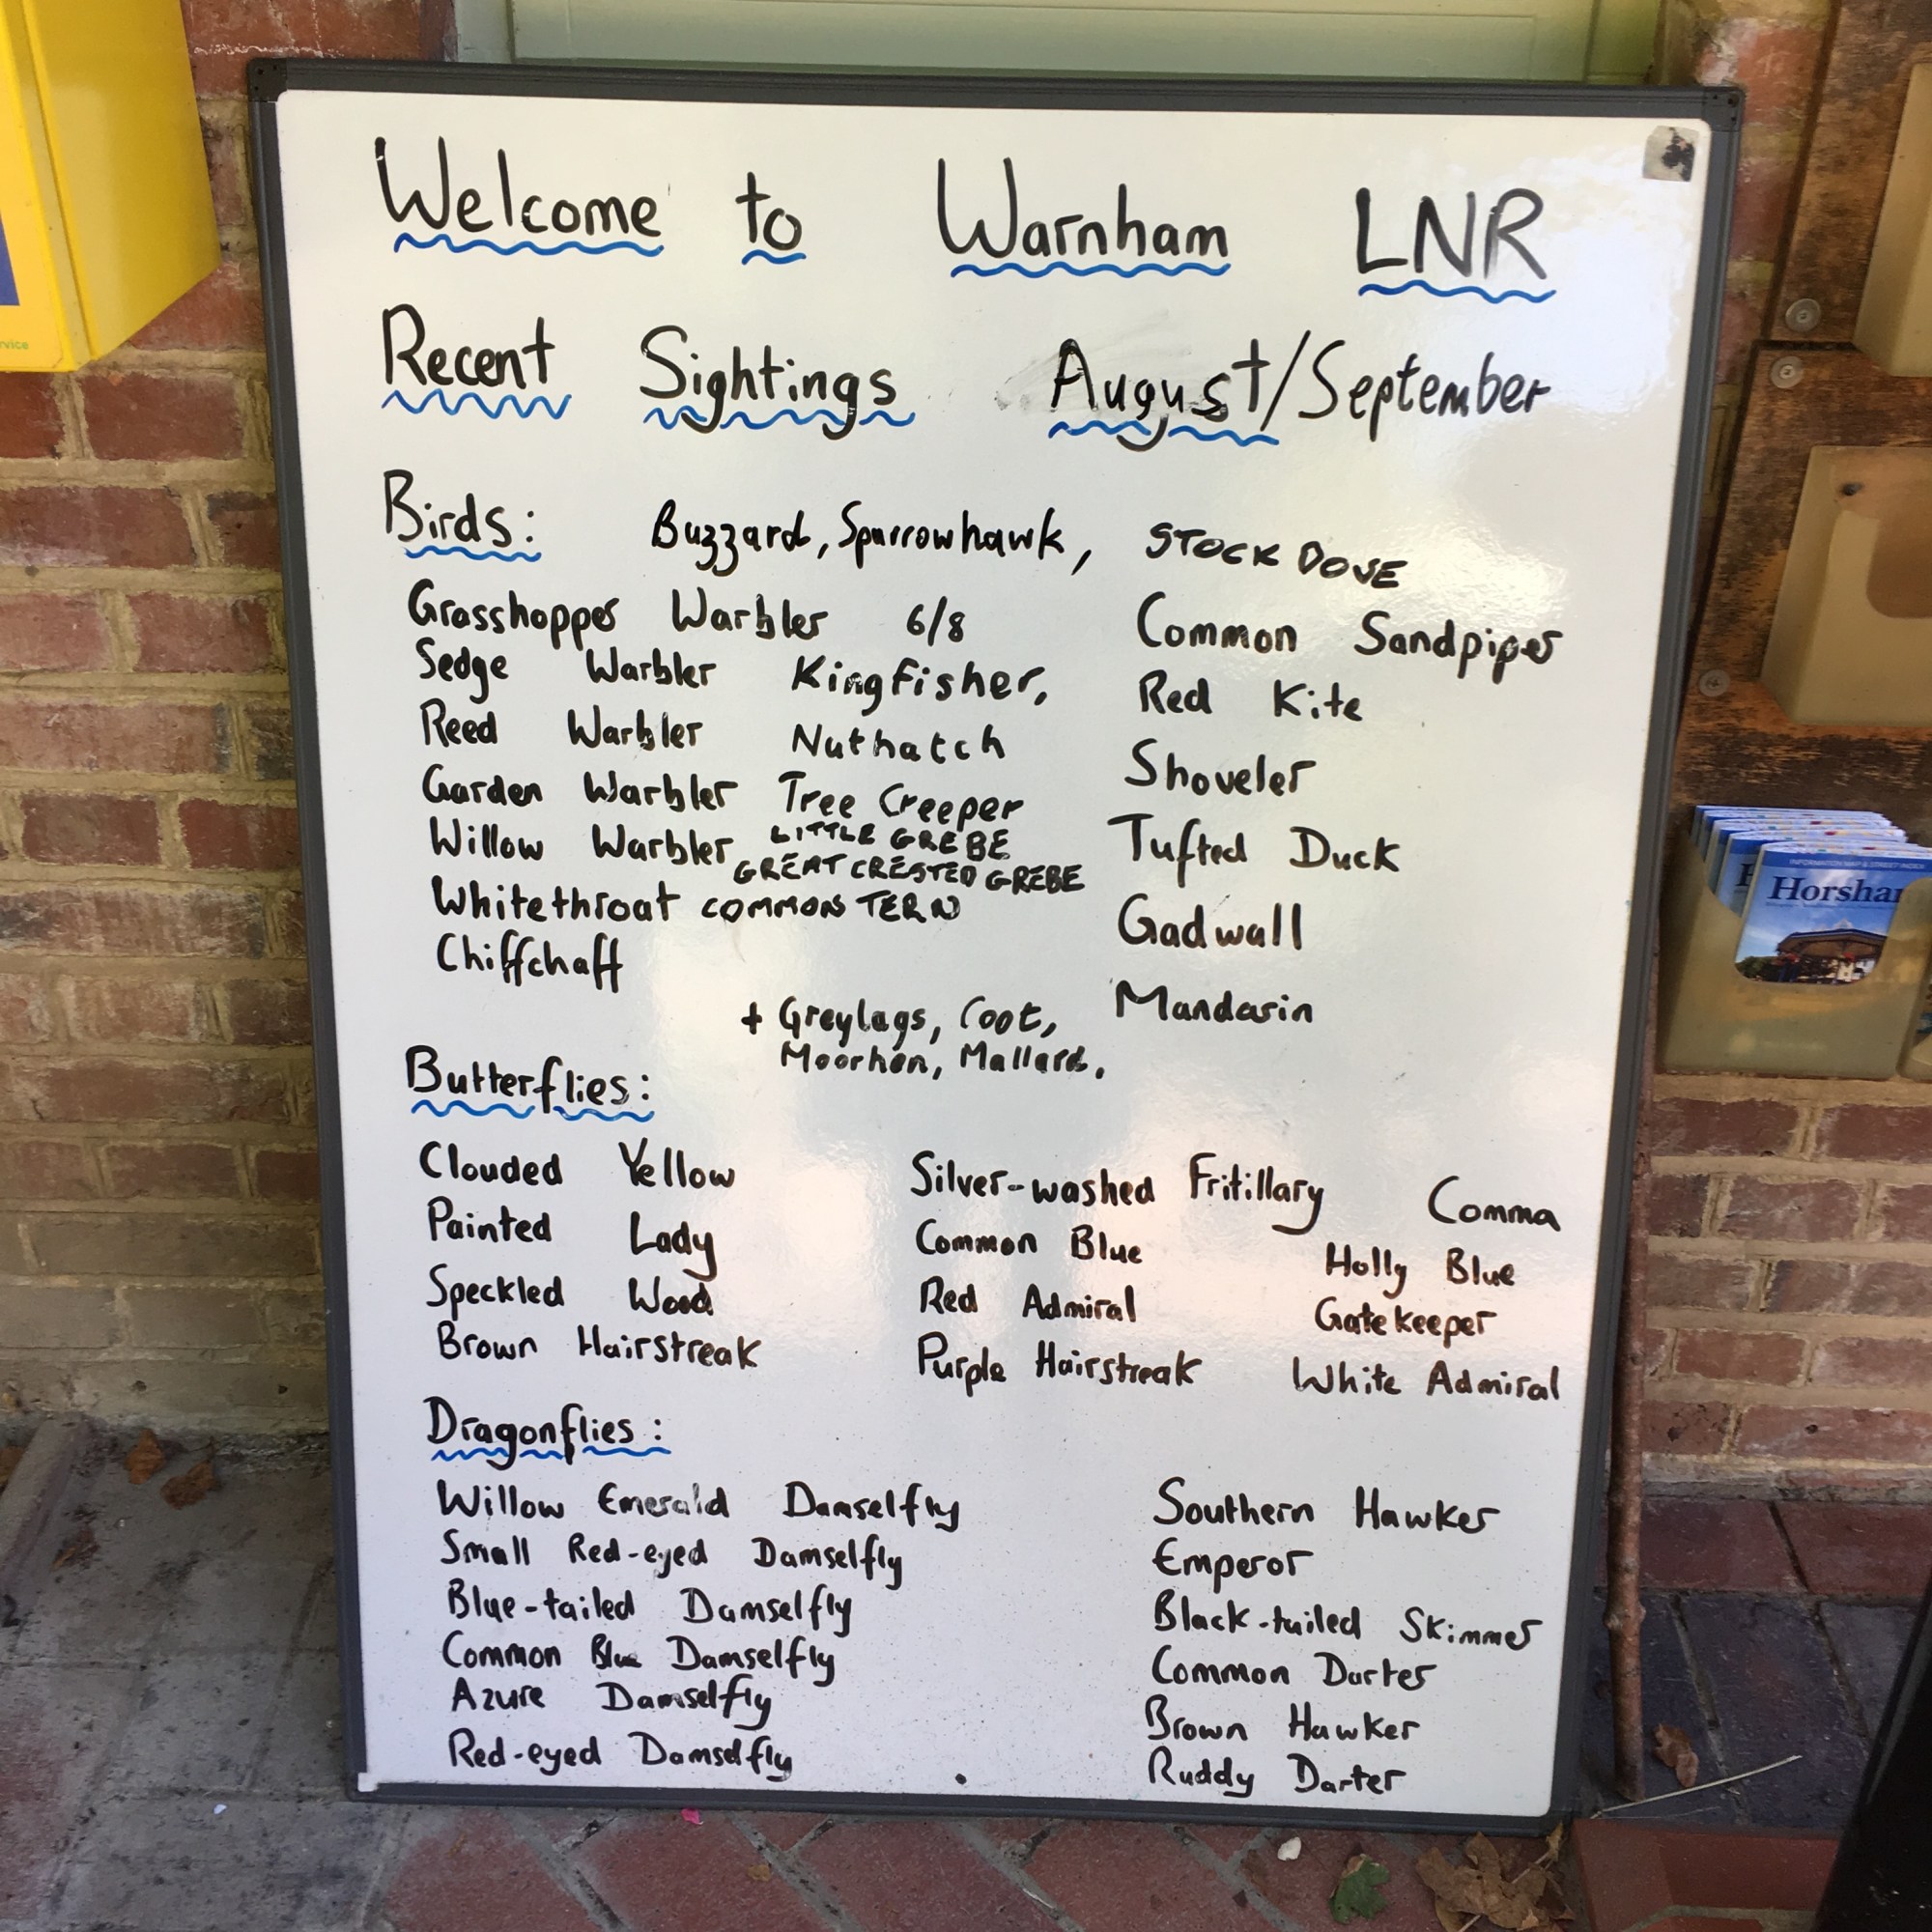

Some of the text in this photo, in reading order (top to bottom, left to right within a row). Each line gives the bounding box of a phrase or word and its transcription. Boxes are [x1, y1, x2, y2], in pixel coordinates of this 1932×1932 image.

[375, 136, 1546, 279] Welcome to Warnham LNR
[383, 304, 554, 389] Recent
[639, 326, 896, 440] Sightings
[384, 469, 533, 548] Birds:
[652, 499, 829, 577] Buzzard,
[1146, 523, 1407, 588] STOCK DOVE
[409, 579, 965, 651] Grasshopper Warbler 6/8
[1137, 591, 1563, 684] Common Sandpiper
[416, 637, 716, 704] Sedge Warbler
[792, 655, 1047, 717] Kingfisher,
[1139, 669, 1362, 722] Red Kite
[420, 698, 702, 751] Reed Warbler
[792, 724, 1005, 764] Nuthatch
[422, 764, 738, 812] Garden Warbler
[1124, 738, 1316, 796] Shoveler
[779, 771, 1024, 832] Tree Creeper
[430, 816, 733, 865] Willow Warbler
[771, 821, 1010, 862] LITTLE GREBE
[1107, 813, 1400, 888] Tufted Duck
[432, 875, 680, 922] Whitethroat
[733, 853, 1085, 895] GREAT CRESTED GREBE
[701, 890, 960, 923] COMMON TERN
[1119, 894, 1301, 951] Gadwall
[437, 929, 623, 993] Chiffchaff
[780, 996, 940, 1051] Greylags,
[960, 996, 1056, 1037] Coot,
[1116, 980, 1312, 1023] Mandarin
[406, 1045, 648, 1114] Butterflies:
[781, 1041, 942, 1080] Moorhen,
[419, 1138, 734, 1188] Clouded Yellow
[911, 1151, 1323, 1236] Silver-washed Fritillary
[1429, 1176, 1560, 1232] Comma
[428, 1196, 717, 1282] Painted Lady
[916, 1219, 1142, 1264] Common Blue
[426, 1264, 713, 1321] Speckled Wood
[921, 1276, 1136, 1322] Red Admiral
[1326, 1242, 1515, 1299] Holly Blue
[438, 1321, 761, 1369] Brown Hairstreak
[1315, 1296, 1496, 1348] Gatekeeper
[918, 1331, 1202, 1397] Purple Hairstreak
[1293, 1356, 1559, 1401] White Admiral
[437, 1479, 959, 1532] Willow Emerald Damselfly
[1153, 1477, 1500, 1534] Southern Hawker
[440, 1528, 901, 1590] Small Red-eyed Damselfly
[1152, 1537, 1314, 1594] Emperor
[448, 1578, 851, 1637] Blue-tailed Damselfly
[1154, 1589, 1543, 1651] Black-tailed Skimmer
[442, 1630, 561, 1668] Common
[666, 1635, 835, 1687] Damselfly
[1152, 1645, 1436, 1690] Common Darter
[452, 1673, 771, 1731] Azure Damselfly
[1146, 1694, 1420, 1741] Brown Hawker
[449, 1728, 601, 1776] Red-eyed
[1149, 1746, 1406, 1798] Ruddy Darter
